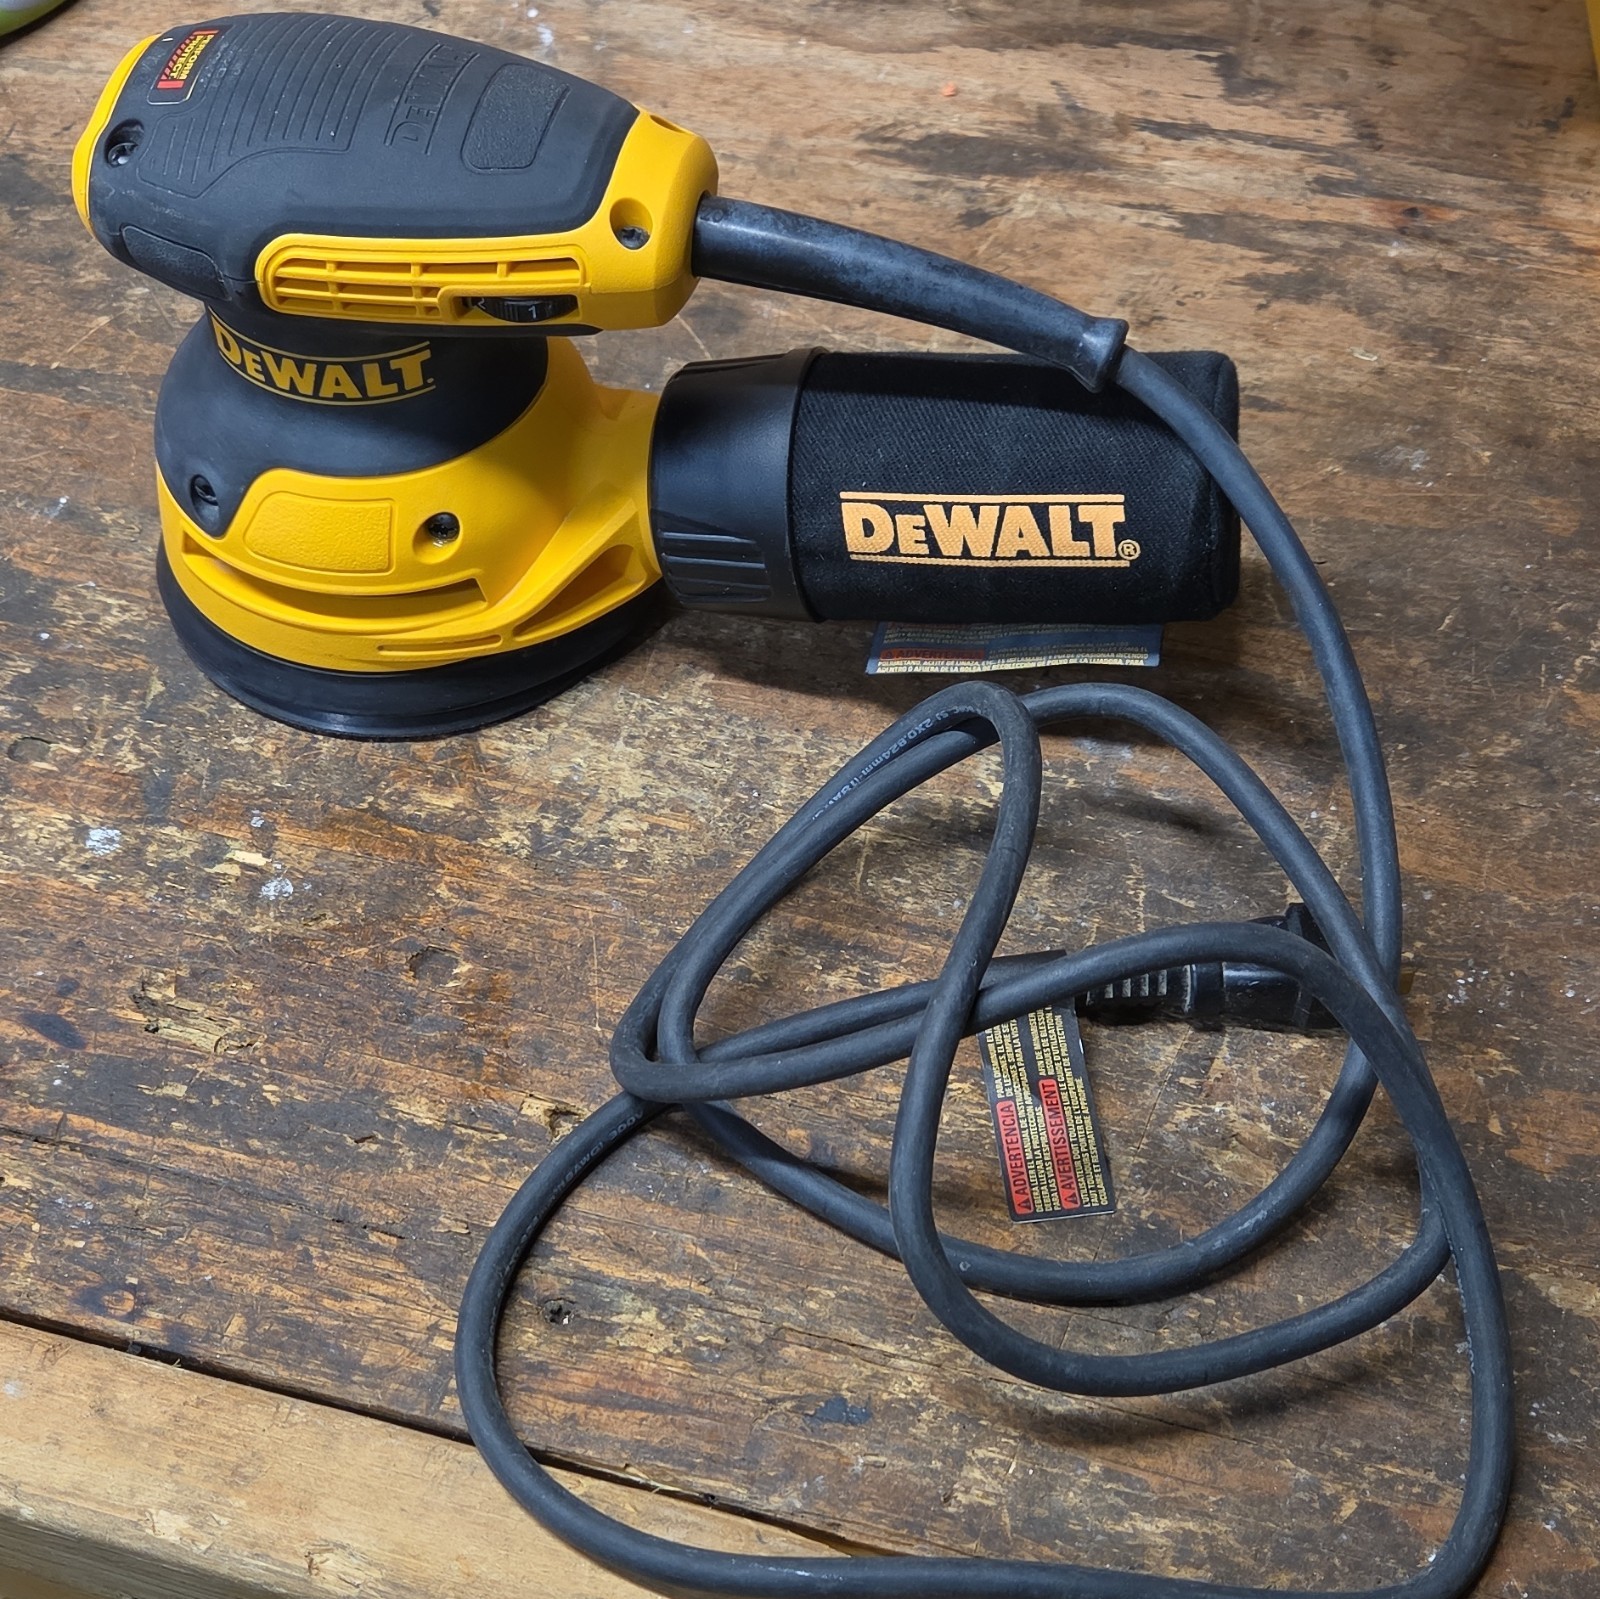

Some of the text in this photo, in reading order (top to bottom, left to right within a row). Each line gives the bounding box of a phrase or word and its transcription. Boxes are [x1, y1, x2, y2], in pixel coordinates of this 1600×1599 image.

[528, 305, 537, 319] 1
[992, 1024, 1003, 1044] USUA
[1053, 1014, 1069, 1056] PROTECTION
[1034, 1050, 1043, 1060] DE
[1036, 1060, 1046, 1077] AFIN
[994, 1078, 1004, 1098] PARA
[1063, 1104, 1077, 1141] TOUJOURS
[1020, 1128, 1033, 1160] MANUAL
[1041, 1081, 1075, 1191] AVERTISSEMENT
[1076, 1124, 1088, 1151] PORTER
[999, 1103, 1028, 1196] ADVERTENCIA
[1070, 1142, 1081, 1159] DOIT
[1050, 1191, 1061, 1210] PARA
